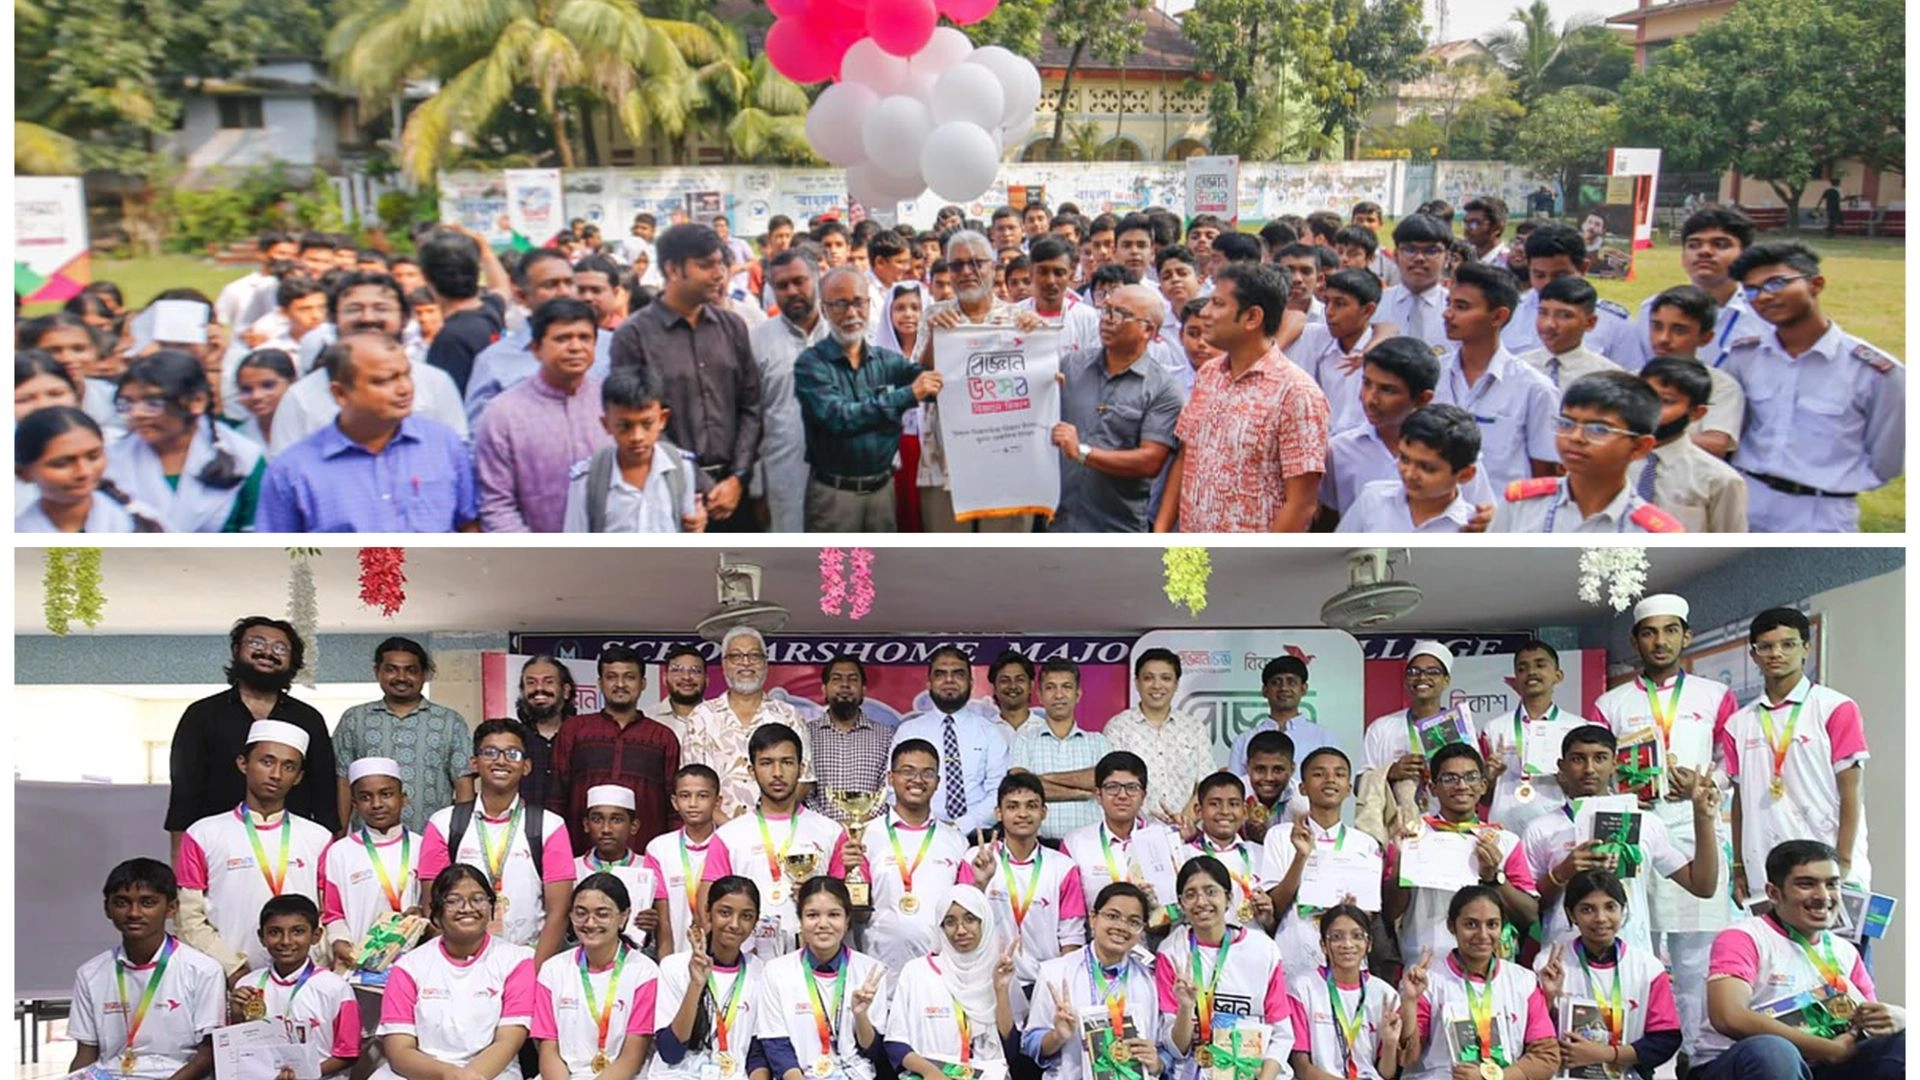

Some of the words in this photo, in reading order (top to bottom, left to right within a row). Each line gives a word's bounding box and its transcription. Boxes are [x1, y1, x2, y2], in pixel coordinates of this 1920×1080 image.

[967, 351, 1026, 375] বিজ্ঞান
[968, 377, 1028, 400] উৎসব
[599, 641, 979, 664] CHOARSHOME
[1006, 643, 1132, 664] MAJO
[1359, 639, 1503, 660] LLGE
